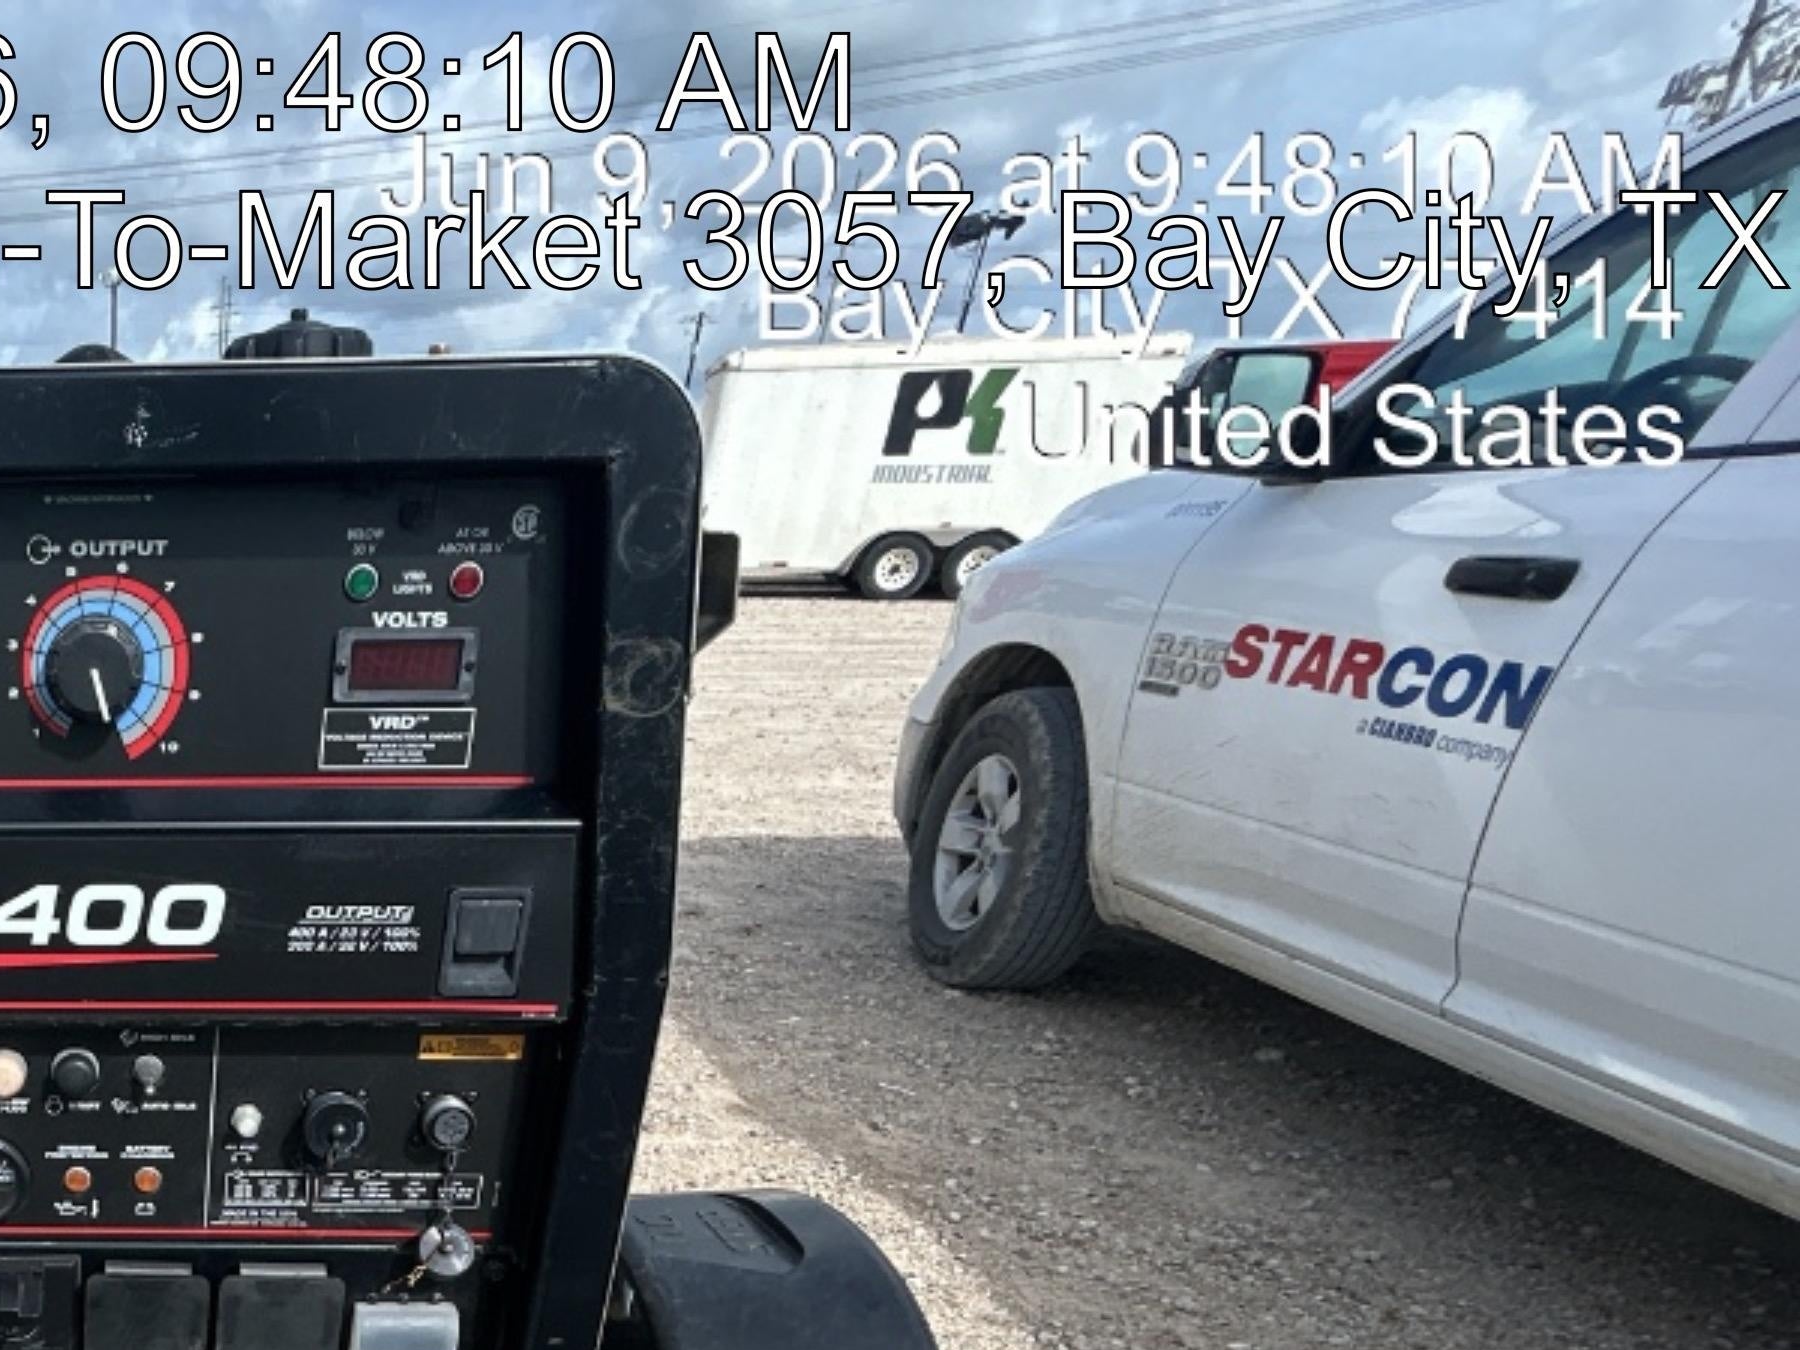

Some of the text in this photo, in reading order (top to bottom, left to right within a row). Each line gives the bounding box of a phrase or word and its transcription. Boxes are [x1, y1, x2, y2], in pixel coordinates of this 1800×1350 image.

[69, 539, 169, 556] OUTPUT
[164, 580, 176, 592] 7
[371, 610, 449, 629] VOLTS
[1223, 623, 1556, 731] STARCON
